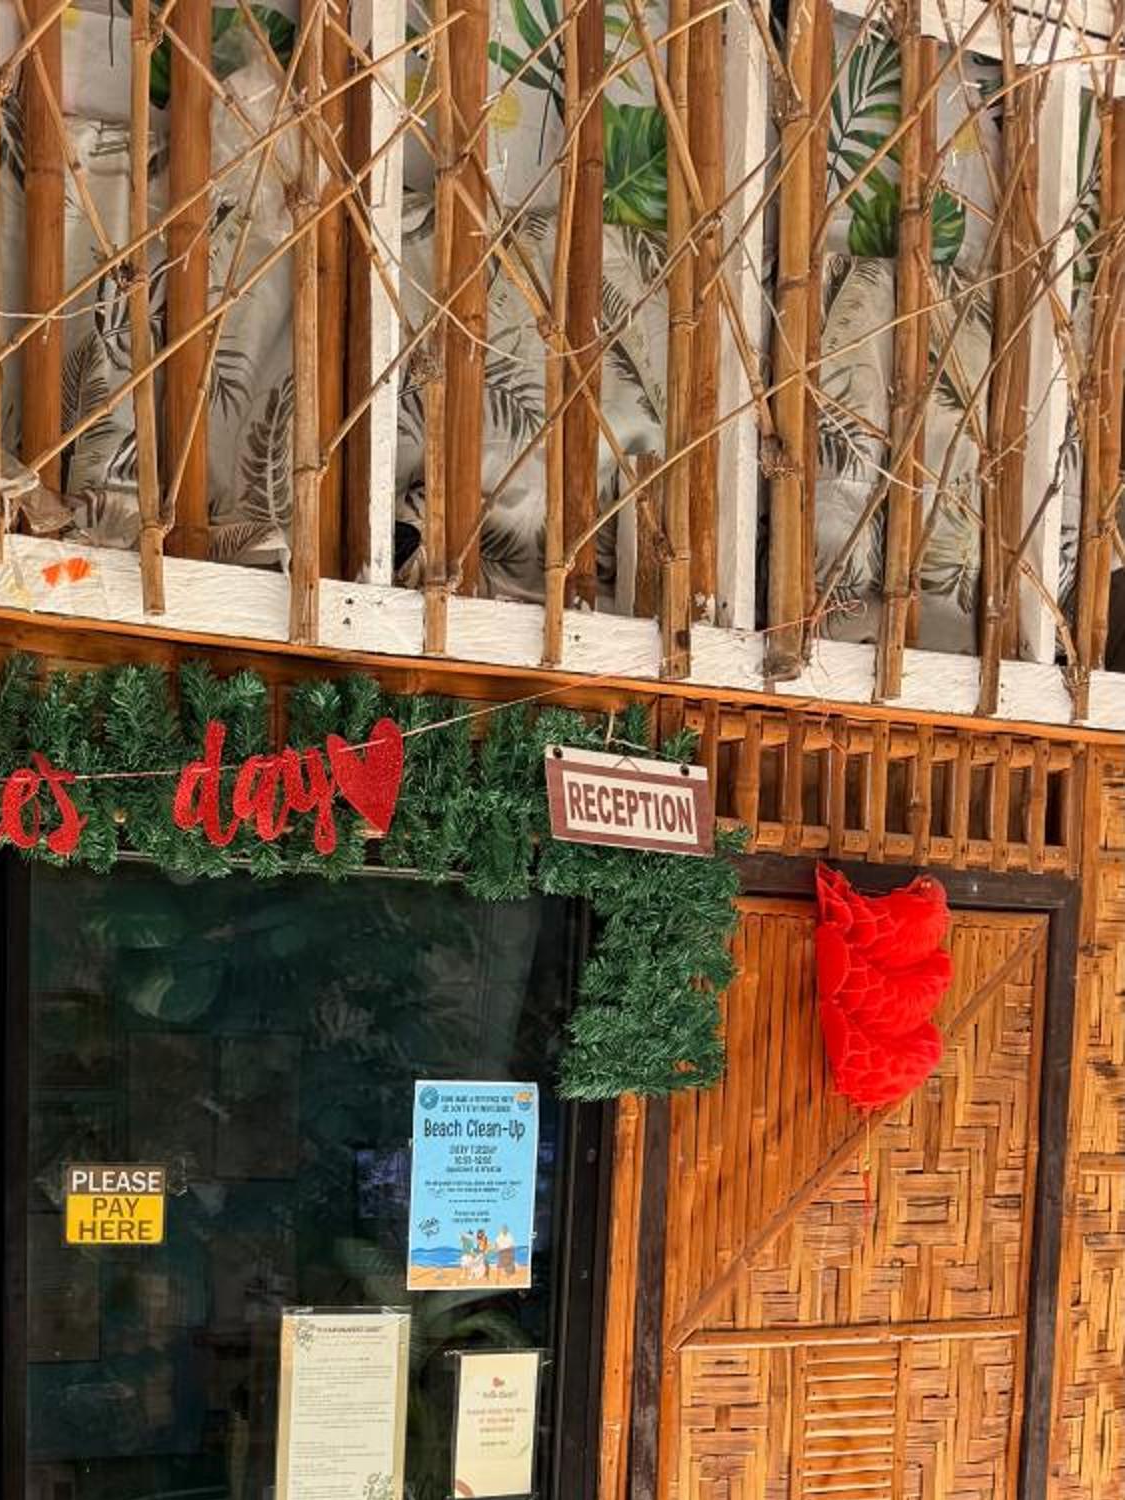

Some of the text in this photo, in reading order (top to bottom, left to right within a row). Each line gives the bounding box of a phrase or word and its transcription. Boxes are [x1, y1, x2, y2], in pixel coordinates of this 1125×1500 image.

[173, 718, 337, 856] day
[567, 781, 694, 835] RECEPTION
[424, 1118, 526, 1142] Beach Clean-Up
[72, 1170, 162, 1192] PLEASE
[92, 1197, 140, 1218] PAY
[78, 1219, 154, 1241] HERE
